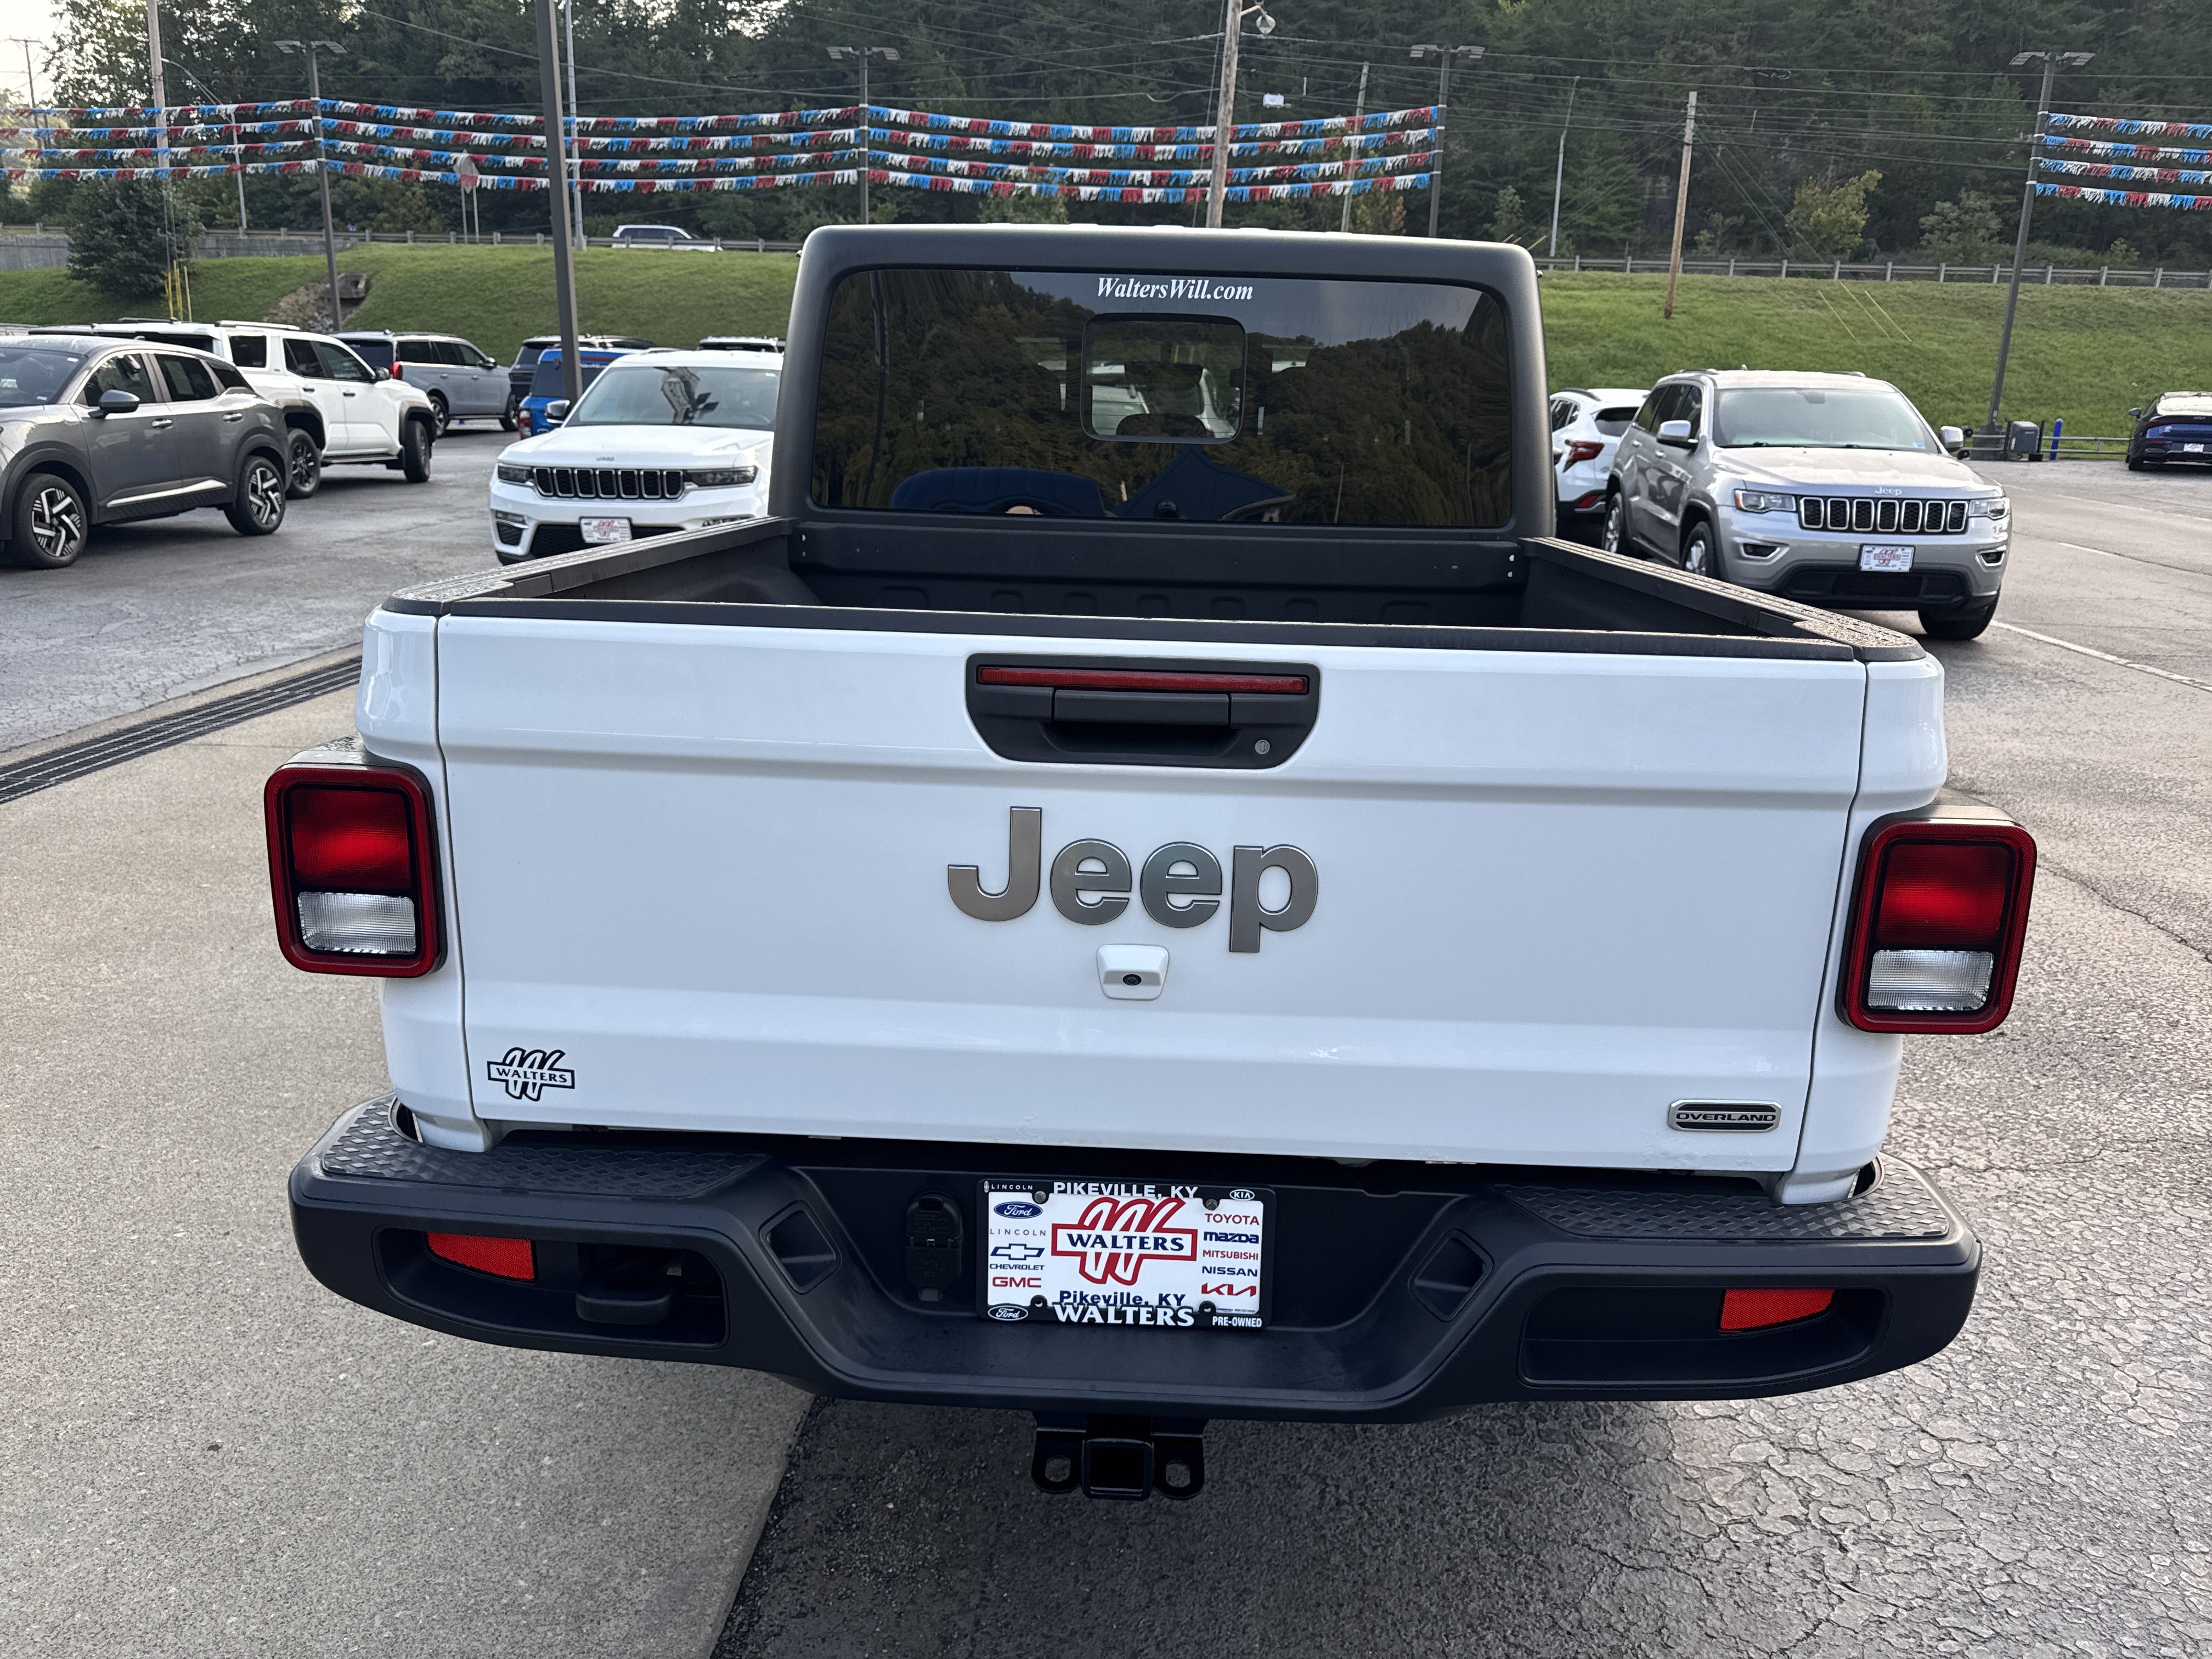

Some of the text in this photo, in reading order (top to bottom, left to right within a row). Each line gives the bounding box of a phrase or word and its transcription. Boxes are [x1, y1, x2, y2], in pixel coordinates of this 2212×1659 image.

[1097, 278, 1254, 300] WaltersWill.com
[947, 806, 1319, 953] Jeep
[496, 1067, 568, 1084] WALTERS
[1675, 1113, 1776, 1121] OVERLAND
[1053, 1182, 1198, 1200] PIKEVILLE, KY
[1003, 1204, 1032, 1217] Ford
[1204, 1213, 1260, 1226] TOYOTA
[1066, 1233, 1184, 1251] WALTERS
[1202, 1250, 1259, 1261] MITSUBISHI
[1201, 1266, 1258, 1277] NISSAN
[992, 1277, 1042, 1288] GMC
[1201, 1283, 1257, 1297] KIA
[1158, 1293, 1186, 1306] KY
[995, 1308, 1020, 1319] Ford
[1052, 1304, 1195, 1327] WALTERS
[1212, 1316, 1262, 1328] PRE-OWNED
